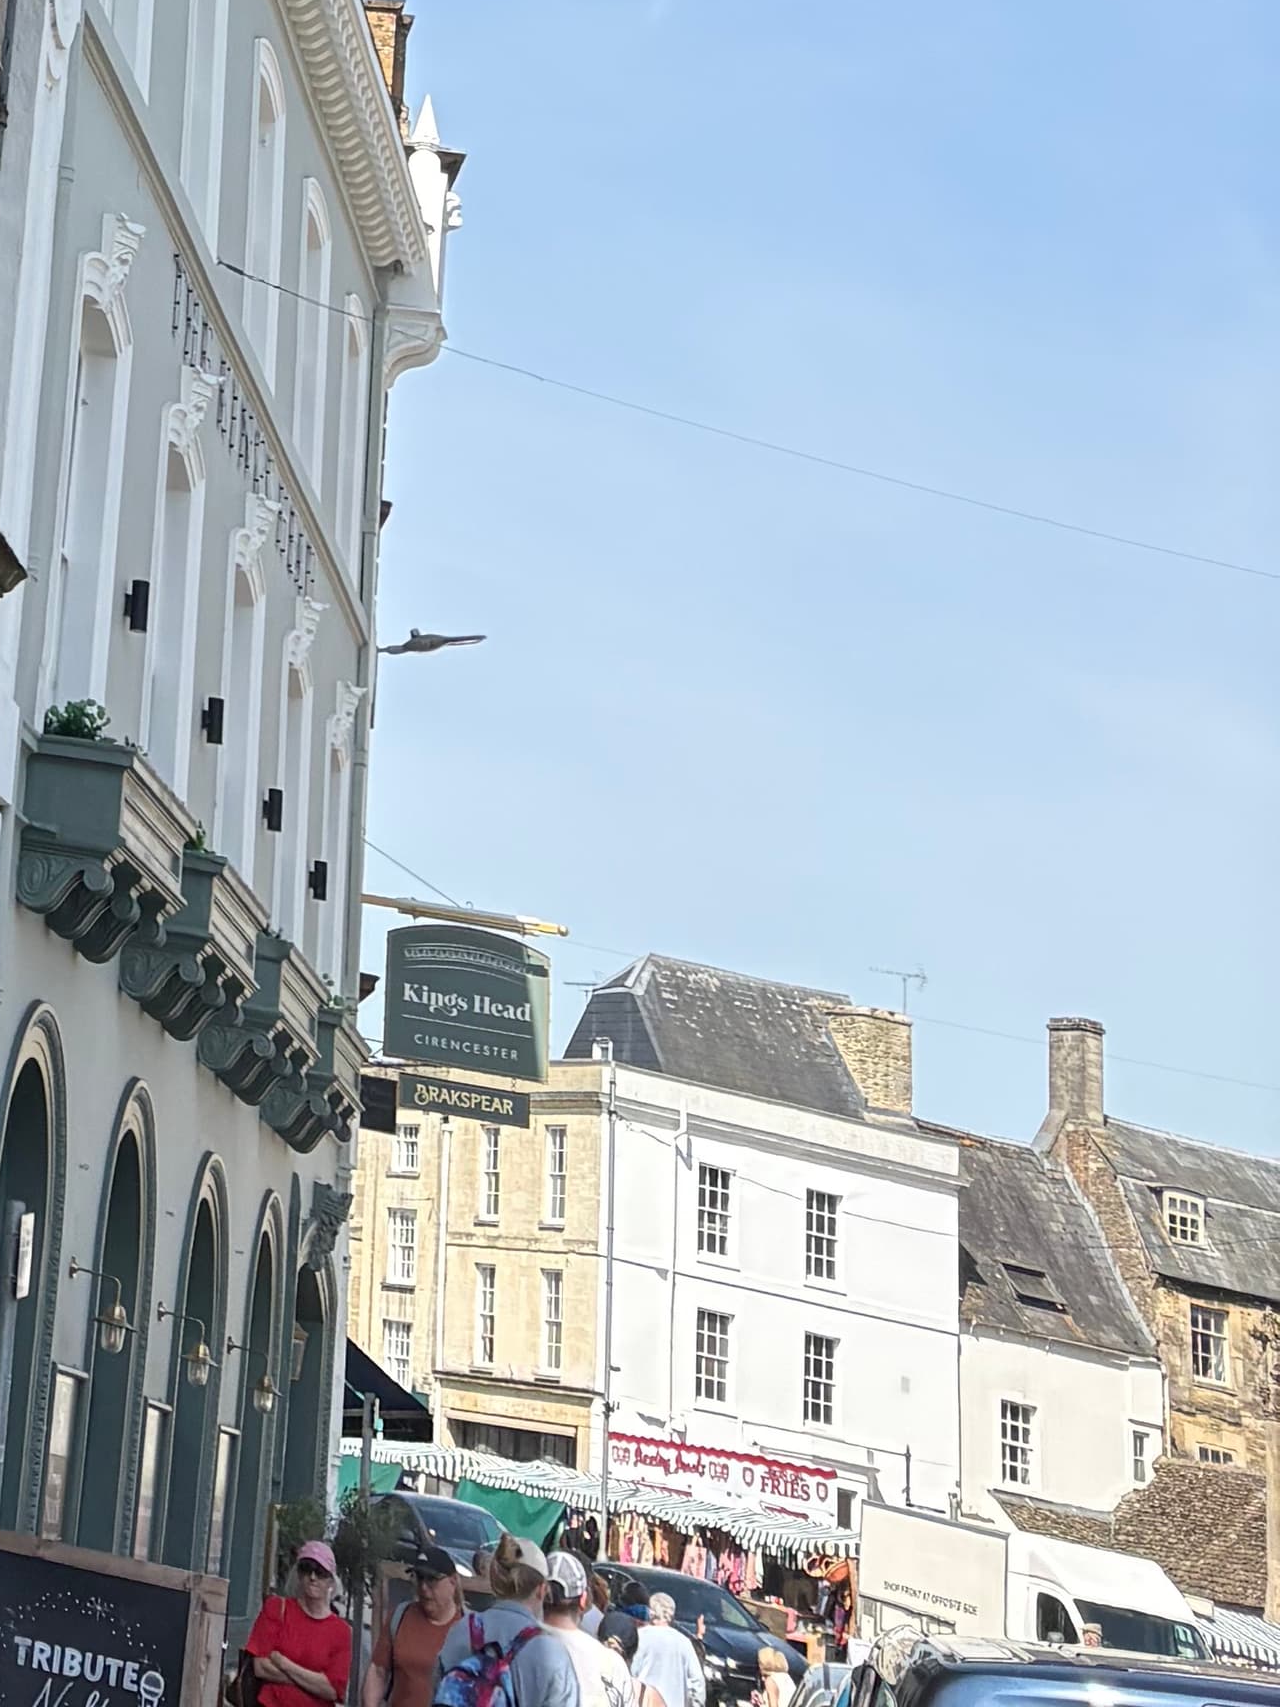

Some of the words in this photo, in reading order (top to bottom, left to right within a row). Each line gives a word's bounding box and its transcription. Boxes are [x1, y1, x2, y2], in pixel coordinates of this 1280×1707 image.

[402, 982, 469, 1017] Kings
[473, 994, 532, 1022] Head
[414, 1033, 519, 1061] CIRENCESTER
[413, 1083, 514, 1116] BRAKSPEAR
[760, 1474, 811, 1502] FRIES
[14, 1635, 140, 1693] TRIBUTE
